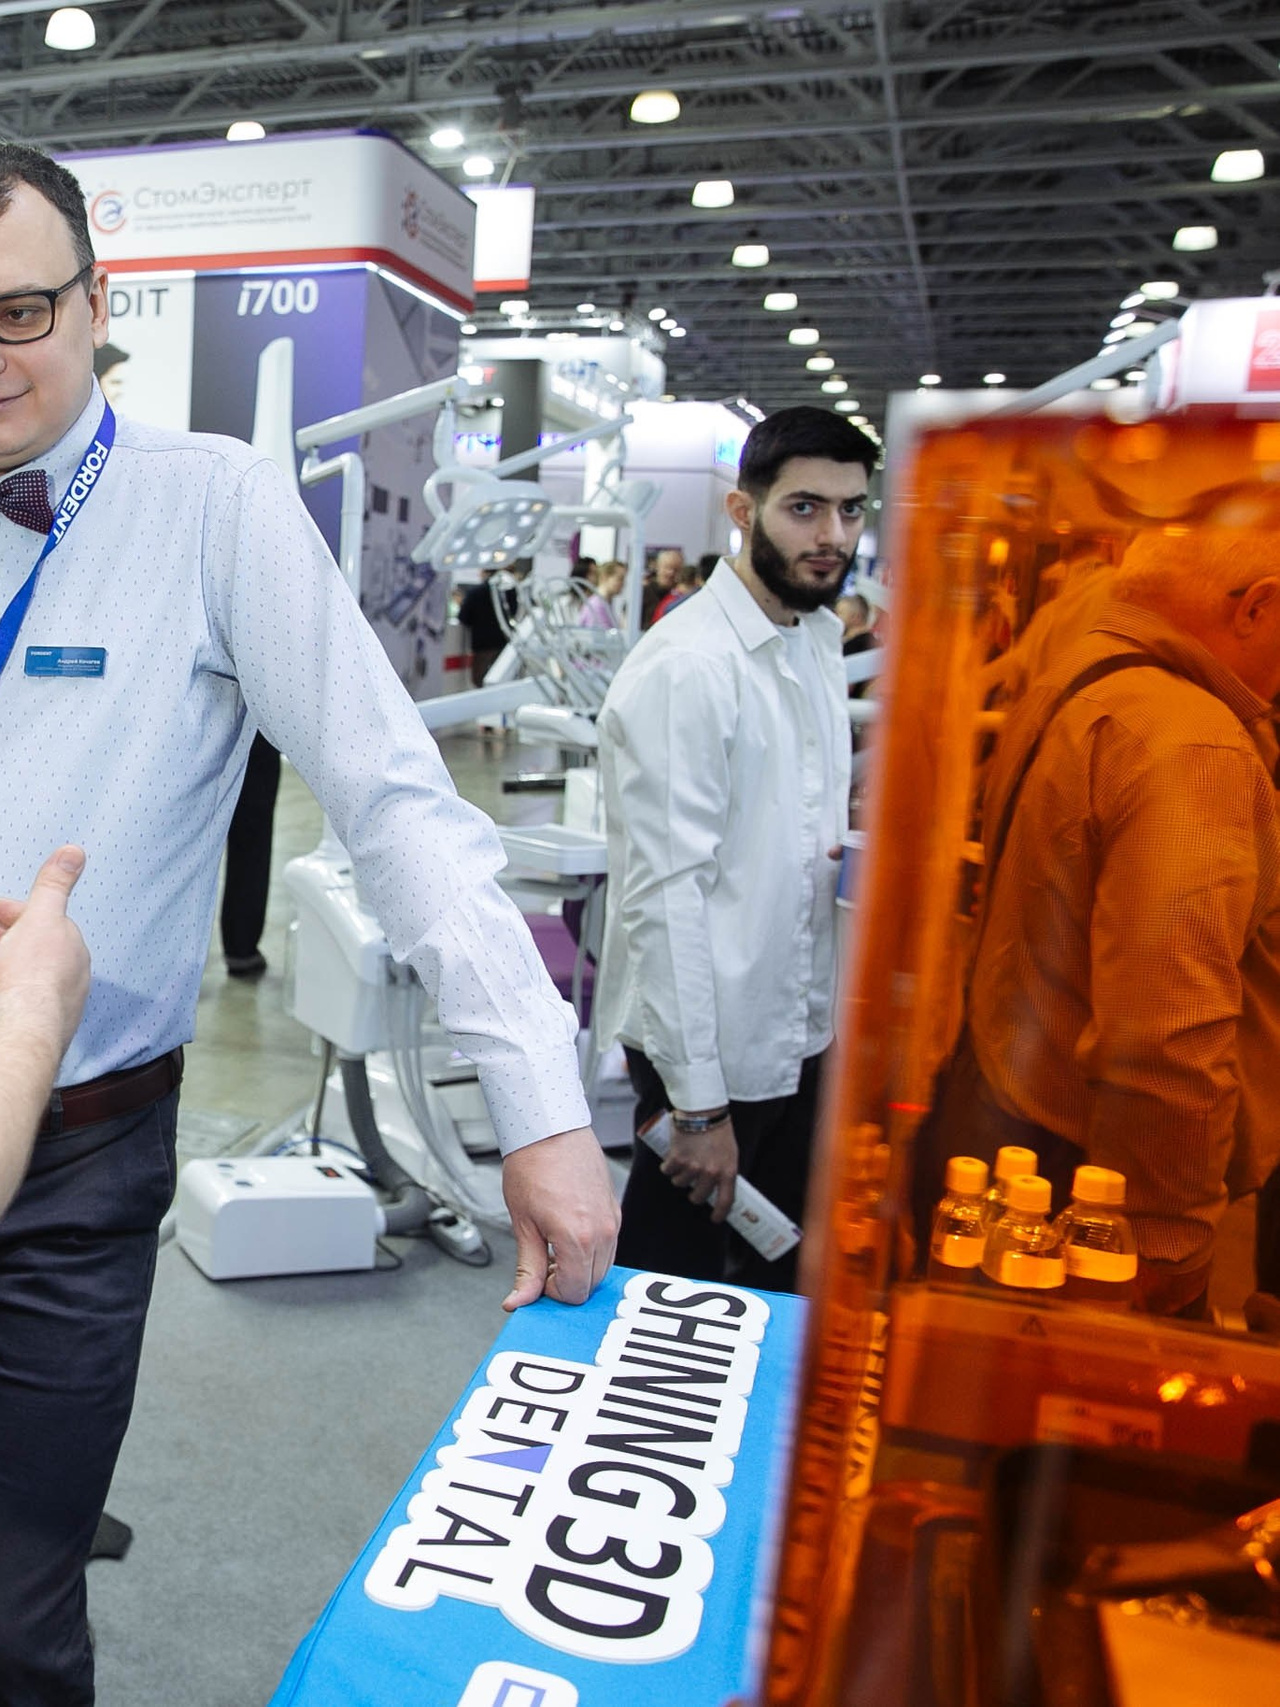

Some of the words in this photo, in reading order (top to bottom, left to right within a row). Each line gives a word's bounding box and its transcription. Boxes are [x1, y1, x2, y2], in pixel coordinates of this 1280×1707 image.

[132, 178, 312, 209] СтомЭксперт
[110, 287, 170, 318] DIT
[237, 277, 320, 316] i700
[52, 440, 108, 544] FORDENT
[393, 1360, 586, 1590] DENTAL
